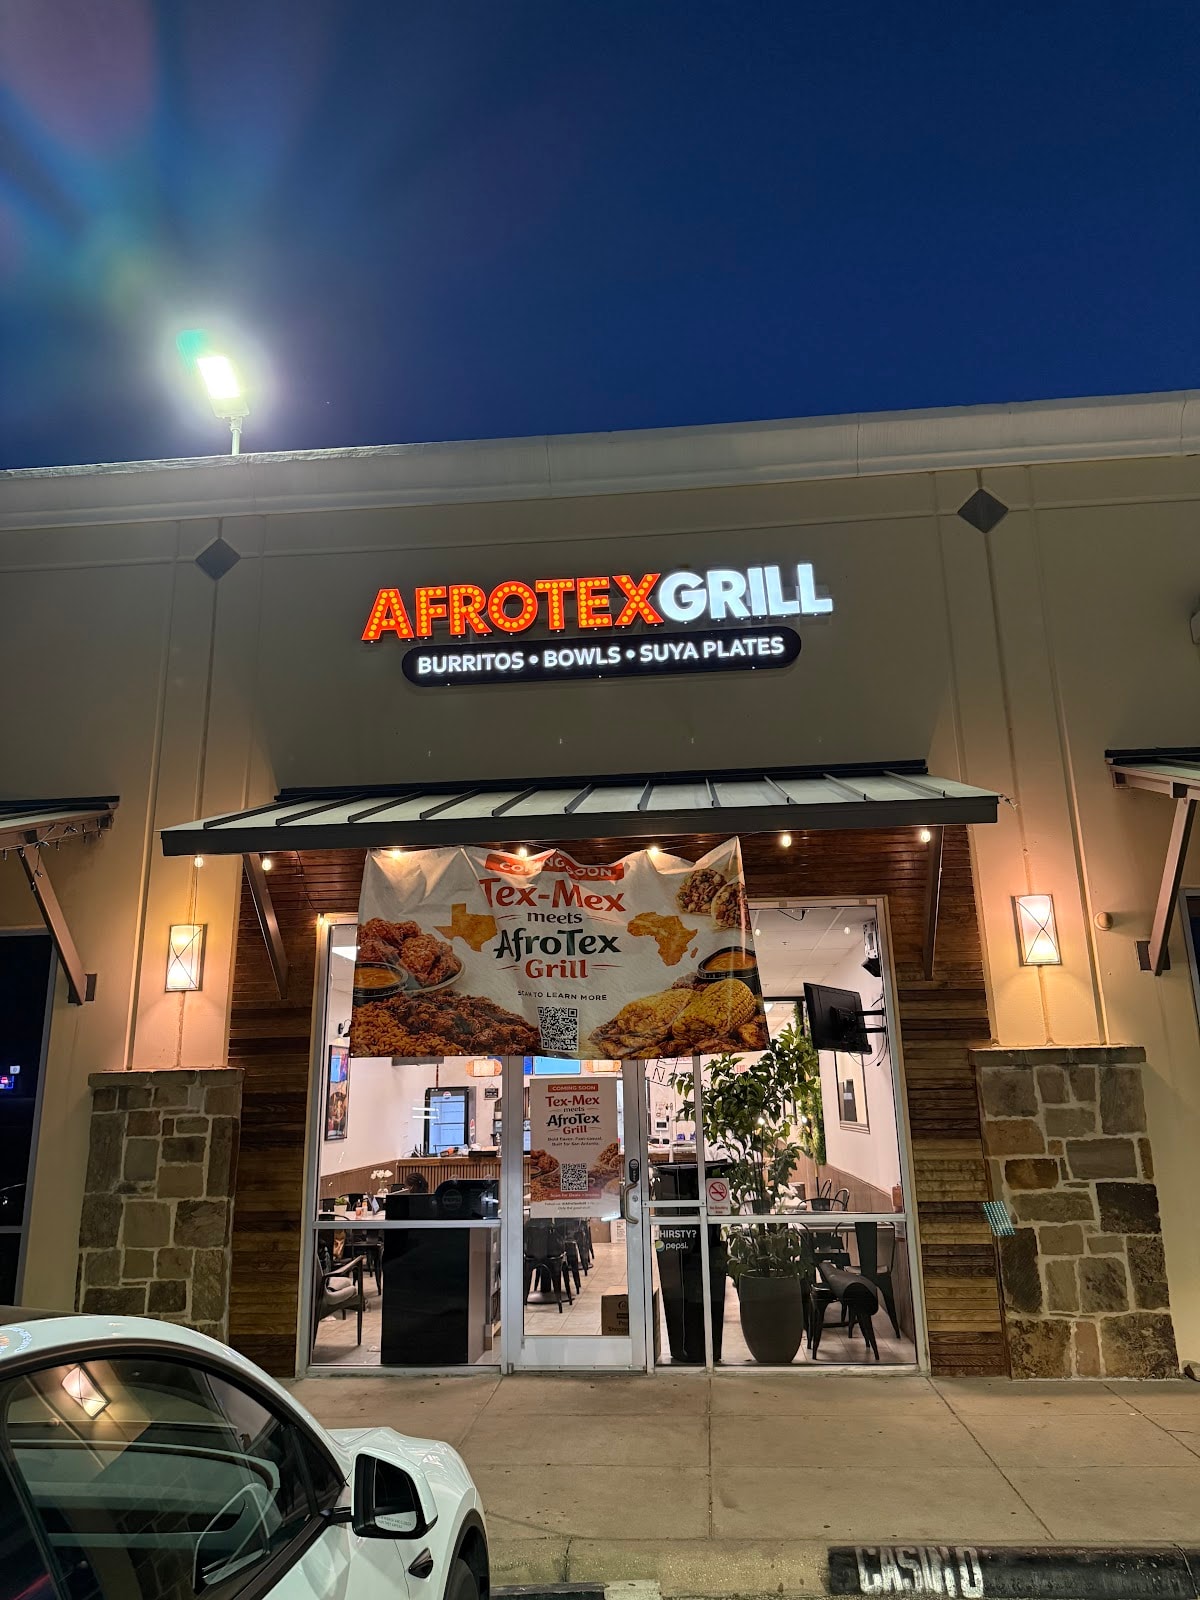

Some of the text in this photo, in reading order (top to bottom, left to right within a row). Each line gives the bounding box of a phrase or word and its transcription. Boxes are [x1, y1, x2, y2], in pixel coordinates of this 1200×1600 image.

[417, 636, 785, 675] BURRITOS BOWLS SUYA PLATES
[565, 866, 612, 878] SOON
[479, 878, 627, 912] Tex-Mex
[527, 912, 583, 925] meets
[493, 927, 622, 962] AfroTex
[525, 958, 589, 979] Grill
[546, 991, 577, 1000] LEARN
[545, 1094, 600, 1107] Tex-Mex
[546, 1113, 600, 1128] AfroTex
[562, 1125, 588, 1135] Grill
[656, 1229, 697, 1239] HIRSTY?
